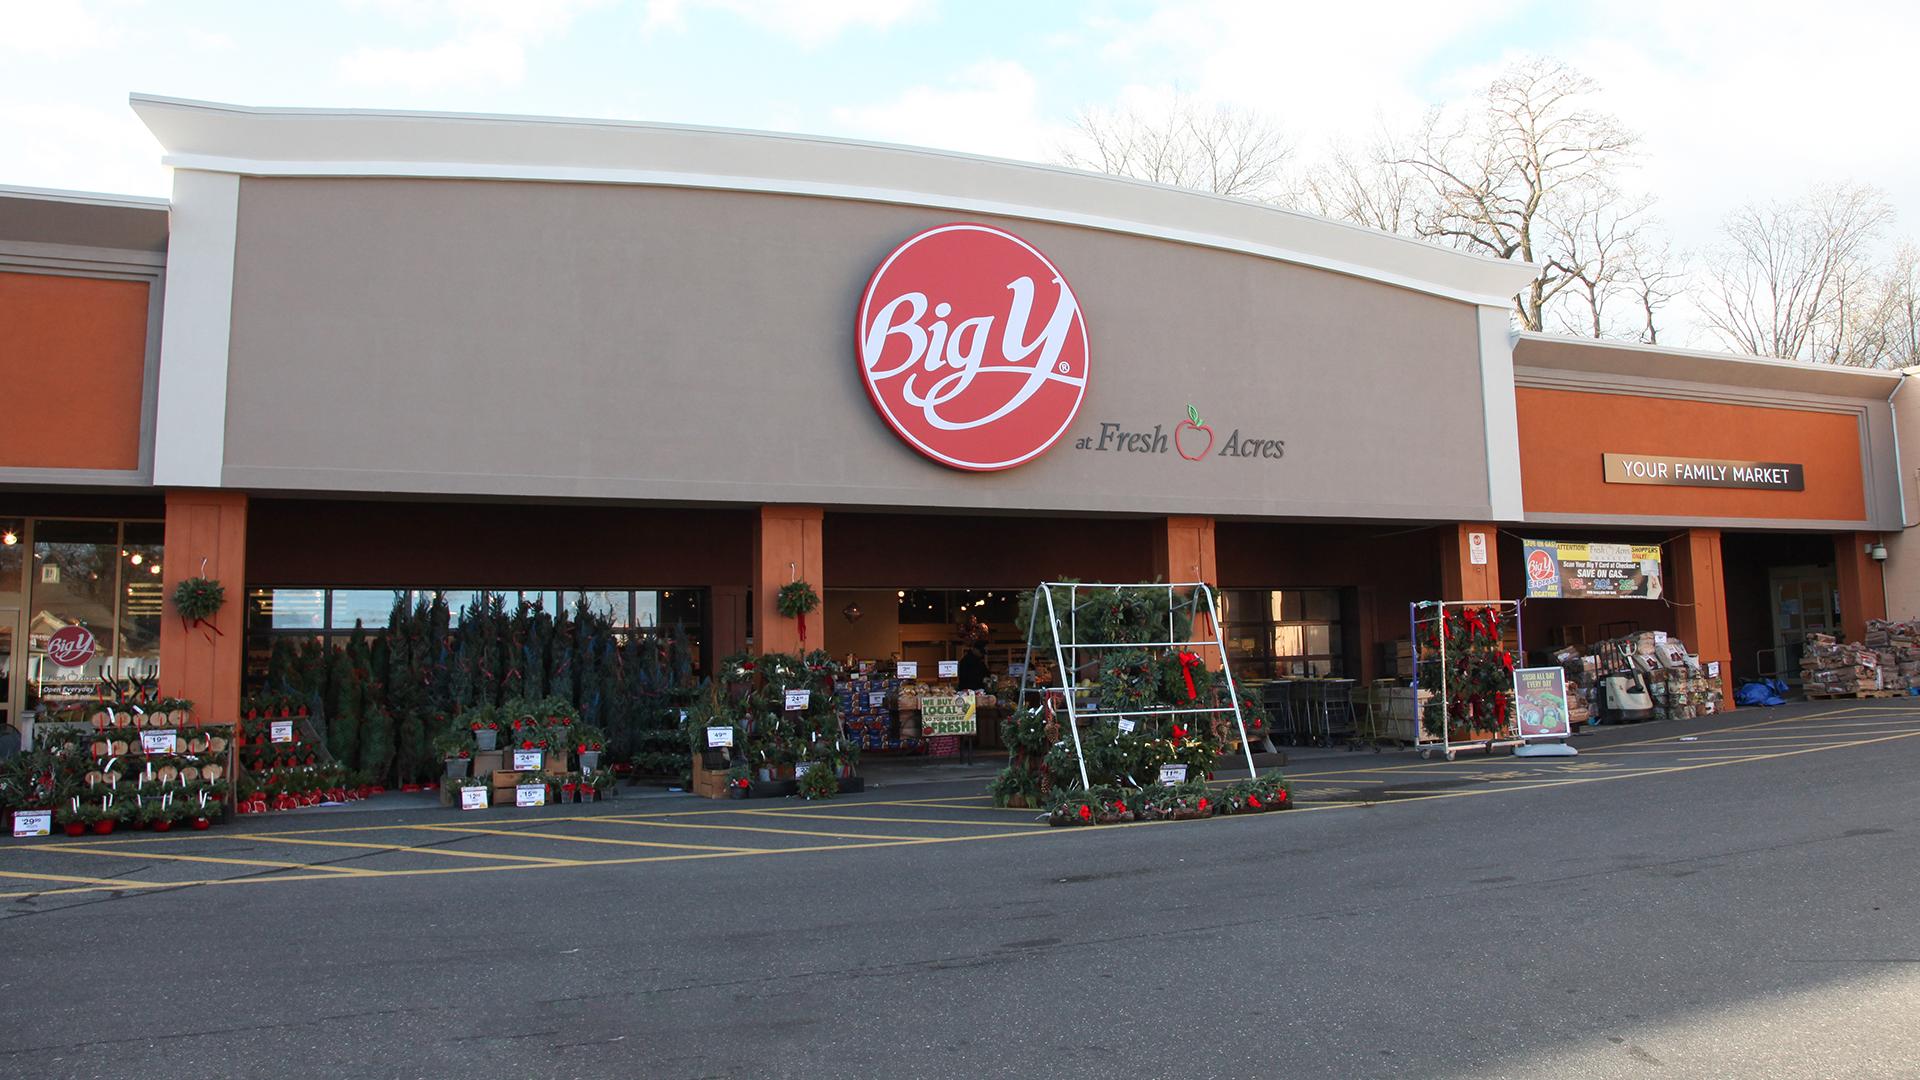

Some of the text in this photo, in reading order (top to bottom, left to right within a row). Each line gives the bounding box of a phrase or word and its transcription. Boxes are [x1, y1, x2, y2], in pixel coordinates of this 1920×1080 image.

[866, 291, 996, 408] Big
[1075, 422, 1286, 459] at Fresh Acres
[1622, 460, 1790, 484] YOUR FAMILY MARKET
[1631, 546, 1659, 554] SHOPPERS
[1577, 569, 1596, 578] SAVE
[1597, 569, 1607, 578] ON
[48, 637, 75, 658] Big
[43, 686, 95, 694] Open Everyday
[937, 698, 953, 706] BUY
[923, 706, 958, 715] LOCAL
[931, 720, 975, 733] FRESH!
